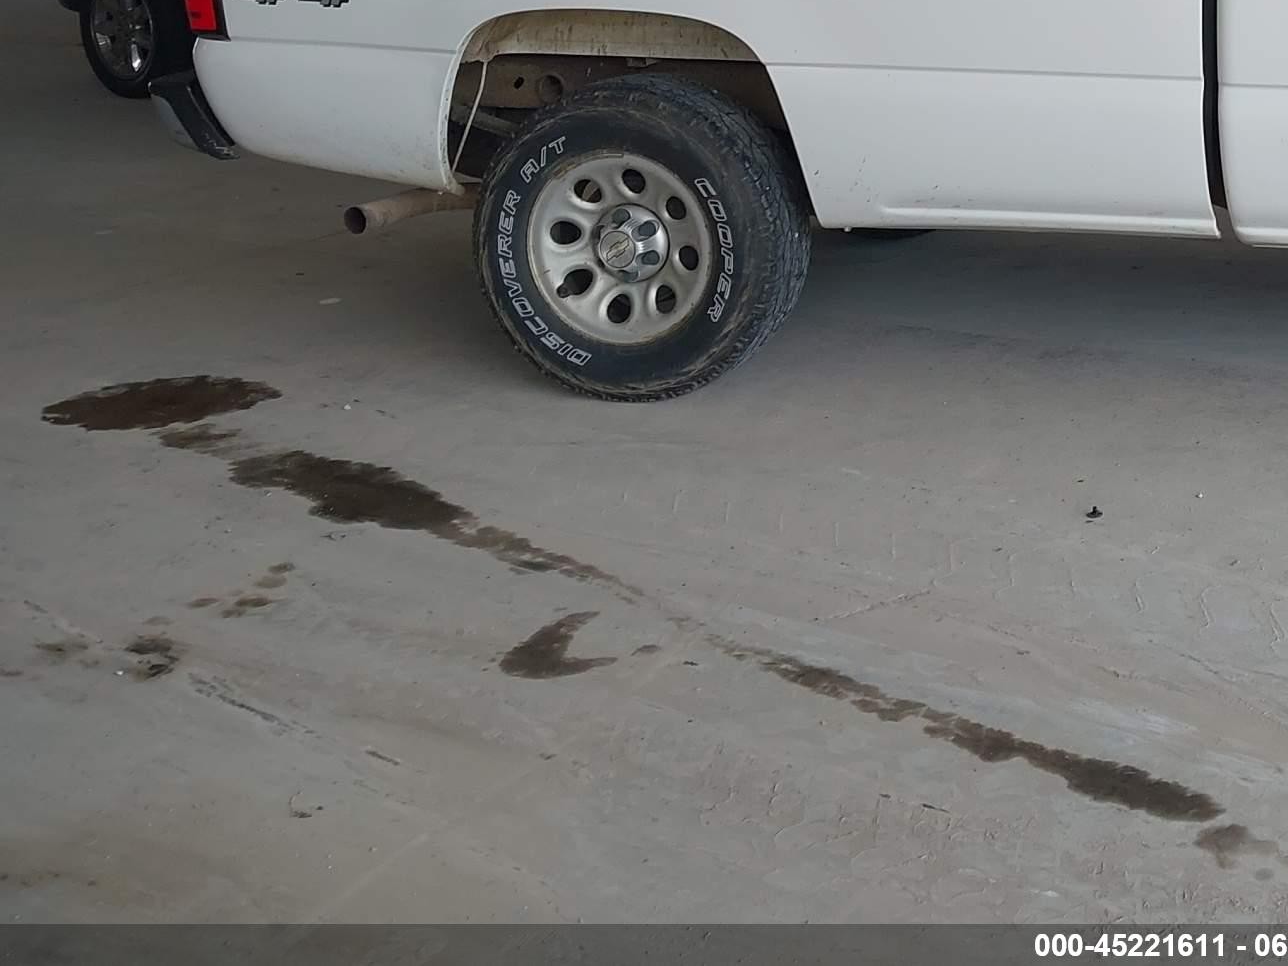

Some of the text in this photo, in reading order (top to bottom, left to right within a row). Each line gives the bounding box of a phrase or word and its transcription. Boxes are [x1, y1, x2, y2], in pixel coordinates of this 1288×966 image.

[497, 136, 592, 366] DISCOVERER A/T
[694, 177, 734, 323] COOPER
